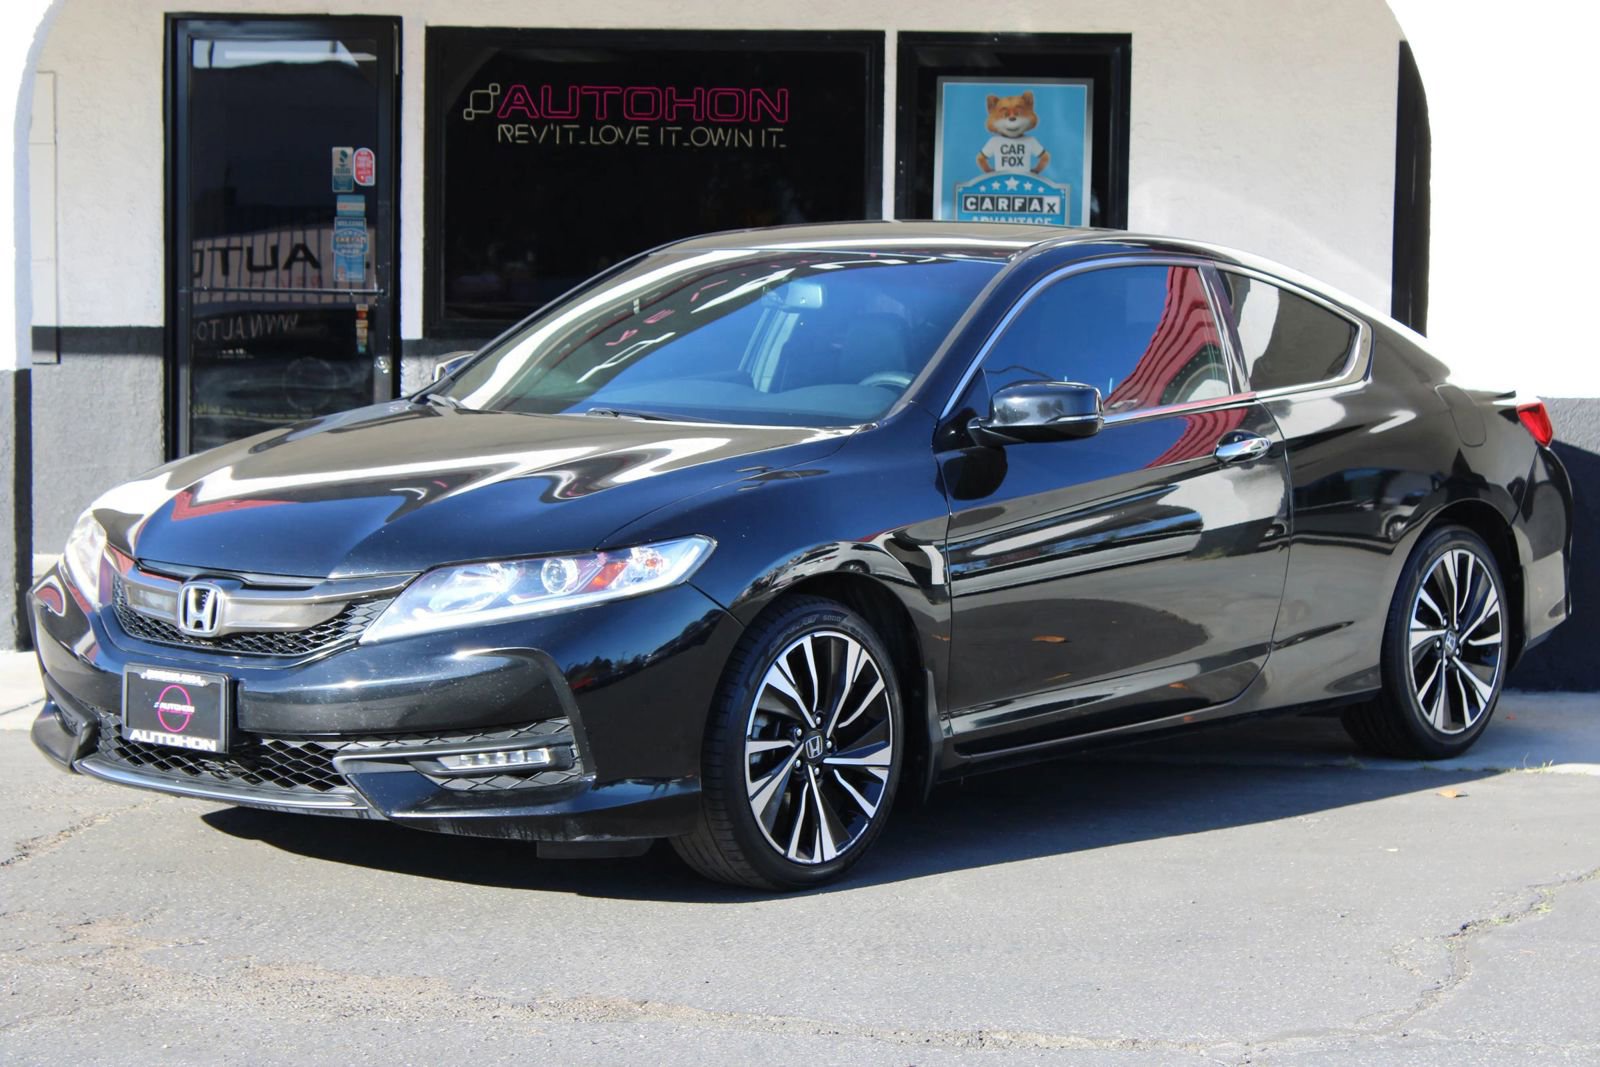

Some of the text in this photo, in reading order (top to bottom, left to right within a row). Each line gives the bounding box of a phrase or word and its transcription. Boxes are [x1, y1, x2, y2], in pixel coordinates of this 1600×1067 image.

[497, 84, 789, 123] AUTOHON
[1000, 143, 1026, 155] CAR
[1001, 156, 1025, 168] FOX
[964, 196, 1058, 214] CARFAX
[129, 728, 217, 752] AUTOHON
